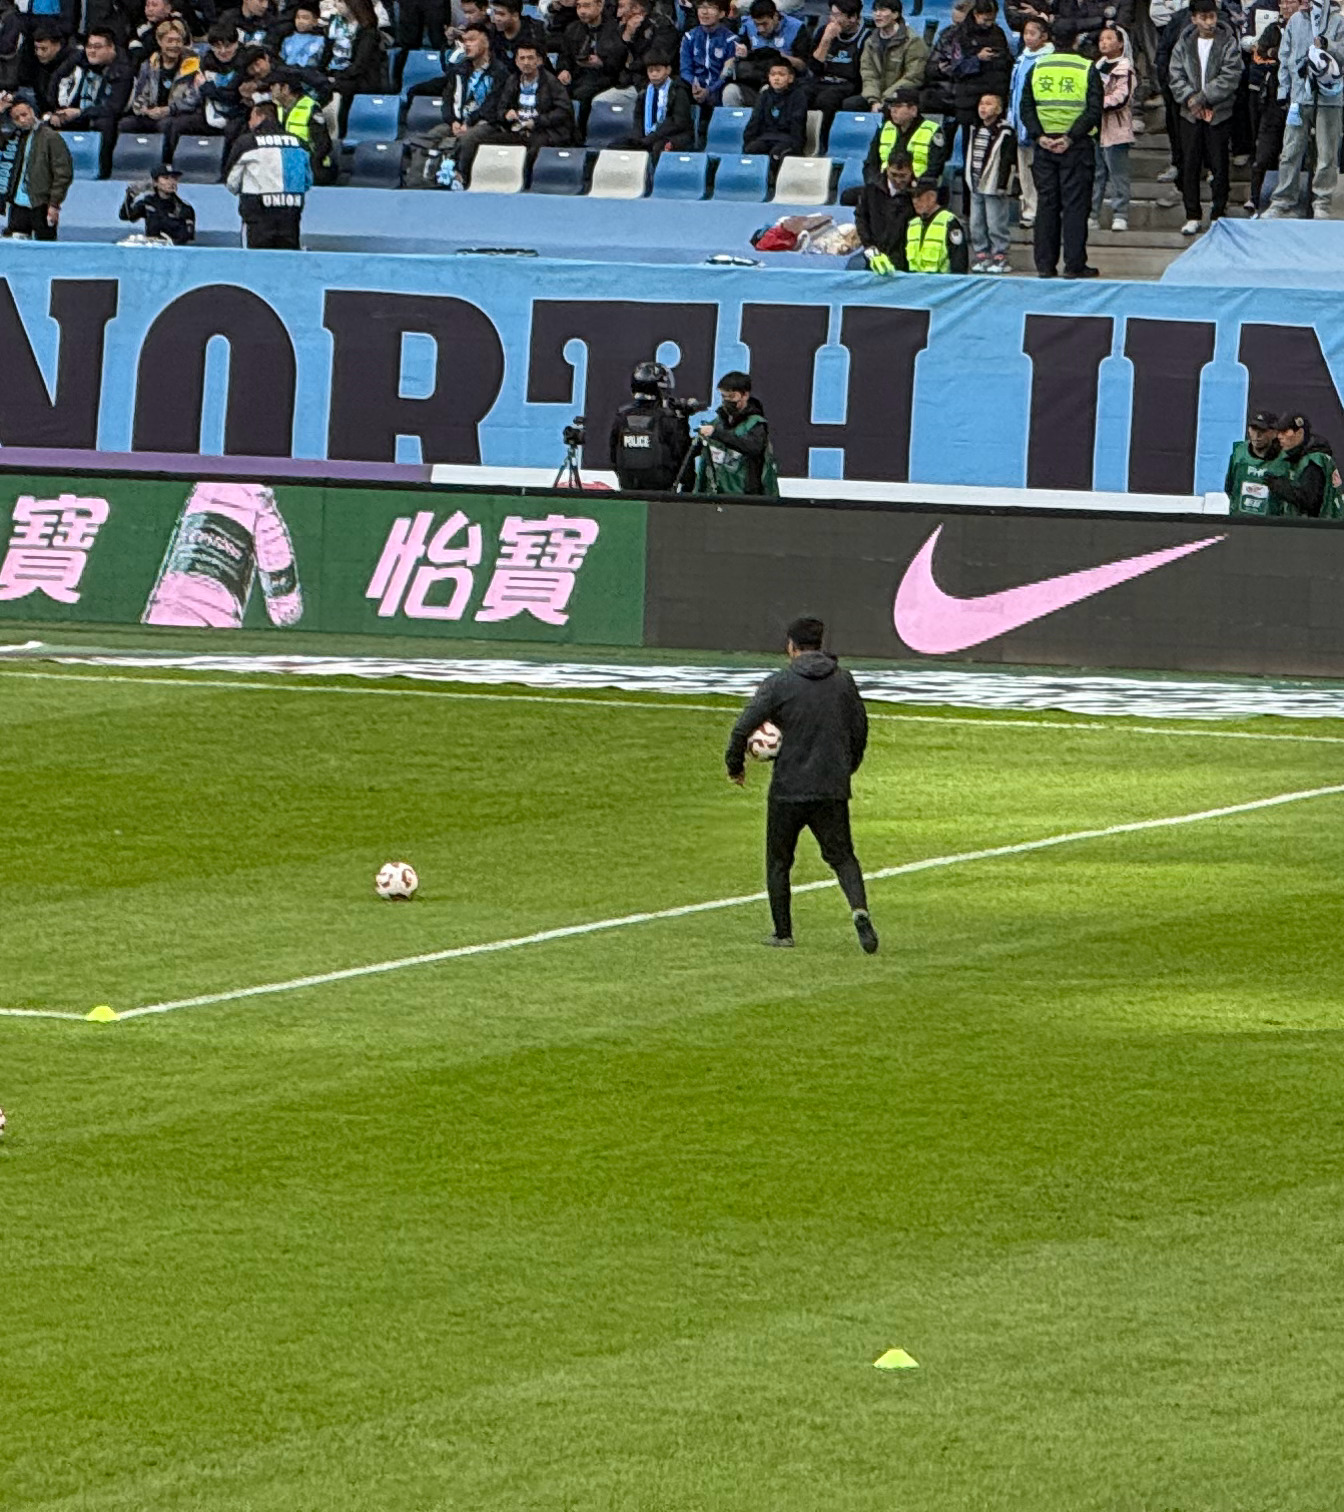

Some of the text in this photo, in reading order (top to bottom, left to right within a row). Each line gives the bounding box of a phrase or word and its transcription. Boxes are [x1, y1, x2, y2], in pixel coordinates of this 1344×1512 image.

[1038, 75, 1077, 94] 安保
[255, 134, 299, 148] NORTH
[0, 274, 930, 484] NORTH
[623, 434, 651, 449] POLICE
